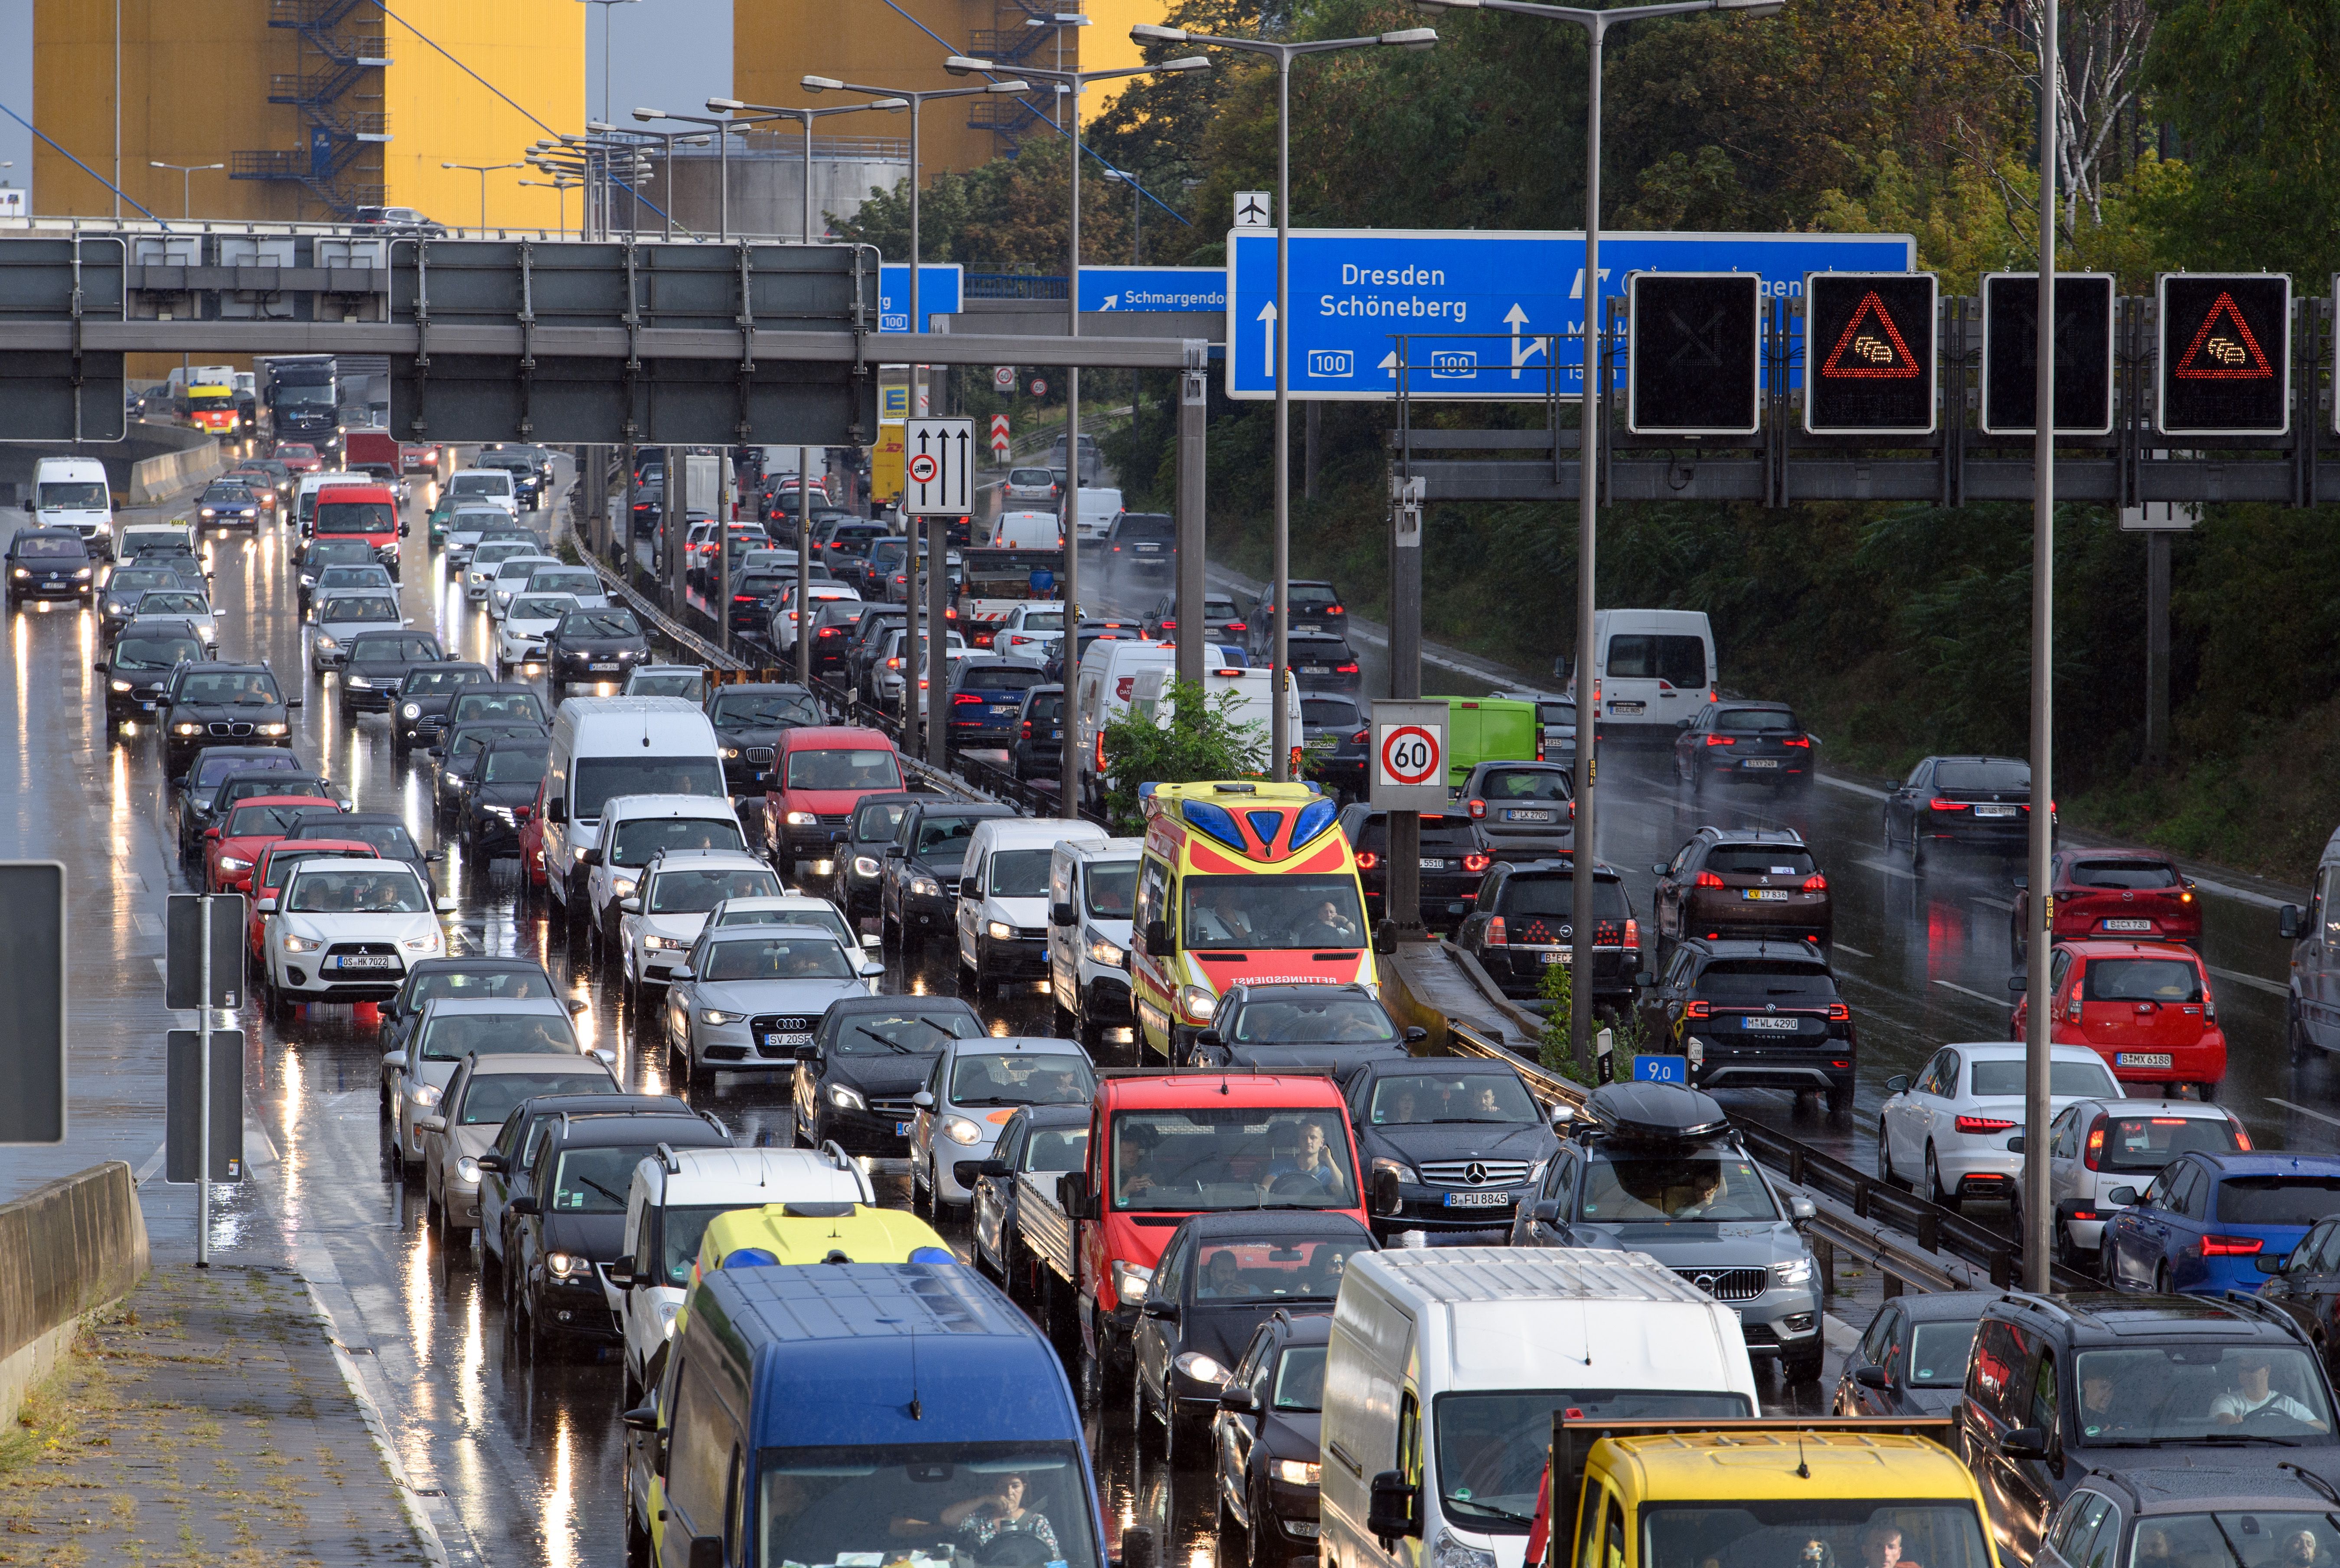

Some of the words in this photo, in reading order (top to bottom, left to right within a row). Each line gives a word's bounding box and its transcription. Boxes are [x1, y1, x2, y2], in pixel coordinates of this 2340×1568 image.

[1342, 264, 1445, 285] Dresden
[1125, 290, 1227, 307] Schmargendo
[1320, 295, 1466, 323] Schöneberg
[885, 317, 903, 327] 100
[1316, 355, 1345, 372] 100
[1440, 357, 1469, 373] 100
[1394, 742, 1427, 769] 60
[2046, 897, 2053, 907] 23
[2046, 907, 2053, 917] 42
[369, 958, 387, 966] 7022
[1748, 1017, 1754, 1027] M
[1760, 1018, 1772, 1027] WL
[1774, 1019, 1796, 1028] 4290
[770, 1035, 783, 1044] SV
[2122, 1055, 2128, 1063] B
[2134, 1055, 2147, 1064] MX
[2147, 1056, 2170, 1065] 6188
[1648, 1062, 1671, 1081] 9,0
[1451, 1194, 1457, 1204] B
[1465, 1194, 1478, 1204] FU
[1481, 1194, 1507, 1204] 8845
